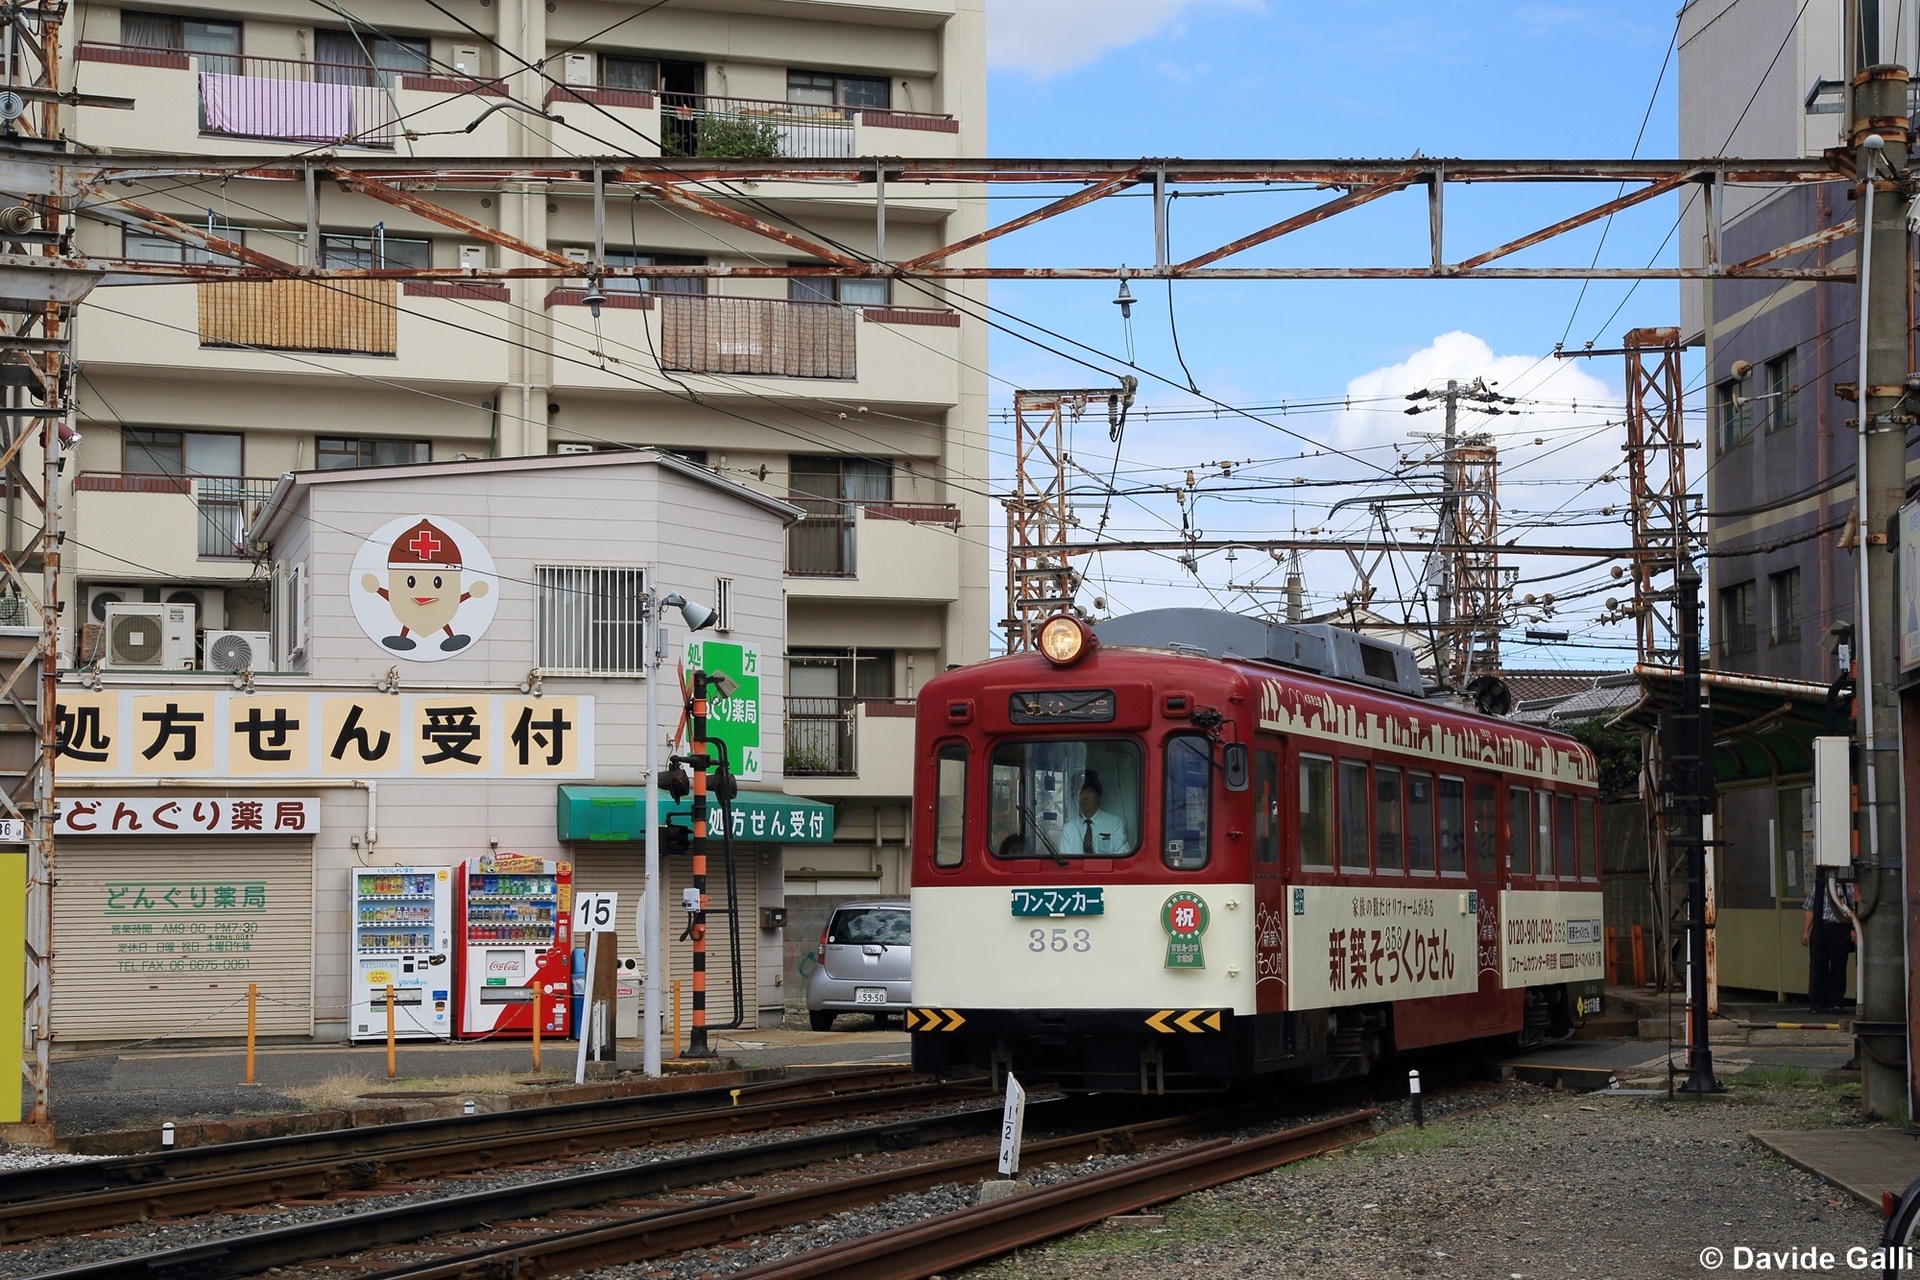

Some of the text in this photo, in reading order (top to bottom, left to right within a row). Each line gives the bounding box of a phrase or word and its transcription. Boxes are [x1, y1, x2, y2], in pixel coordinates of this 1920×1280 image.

[687, 643, 757, 673] 処 方
[55, 704, 571, 766] 処方せん受付
[66, 800, 306, 832] どんぐり薬局
[708, 808, 824, 838] 処方せん受付
[107, 886, 266, 909] どんぐり薬局
[1014, 891, 1100, 912] ワンマンカー
[581, 899, 611, 926] 15
[1175, 907, 1195, 927] 祝
[1028, 928, 1091, 953] 353
[1384, 926, 1403, 951] 353
[1328, 928, 1455, 991] 新築そっくりさん
[1005, 1125, 1011, 1139] 2
[1003, 1150, 1009, 1164] 4
